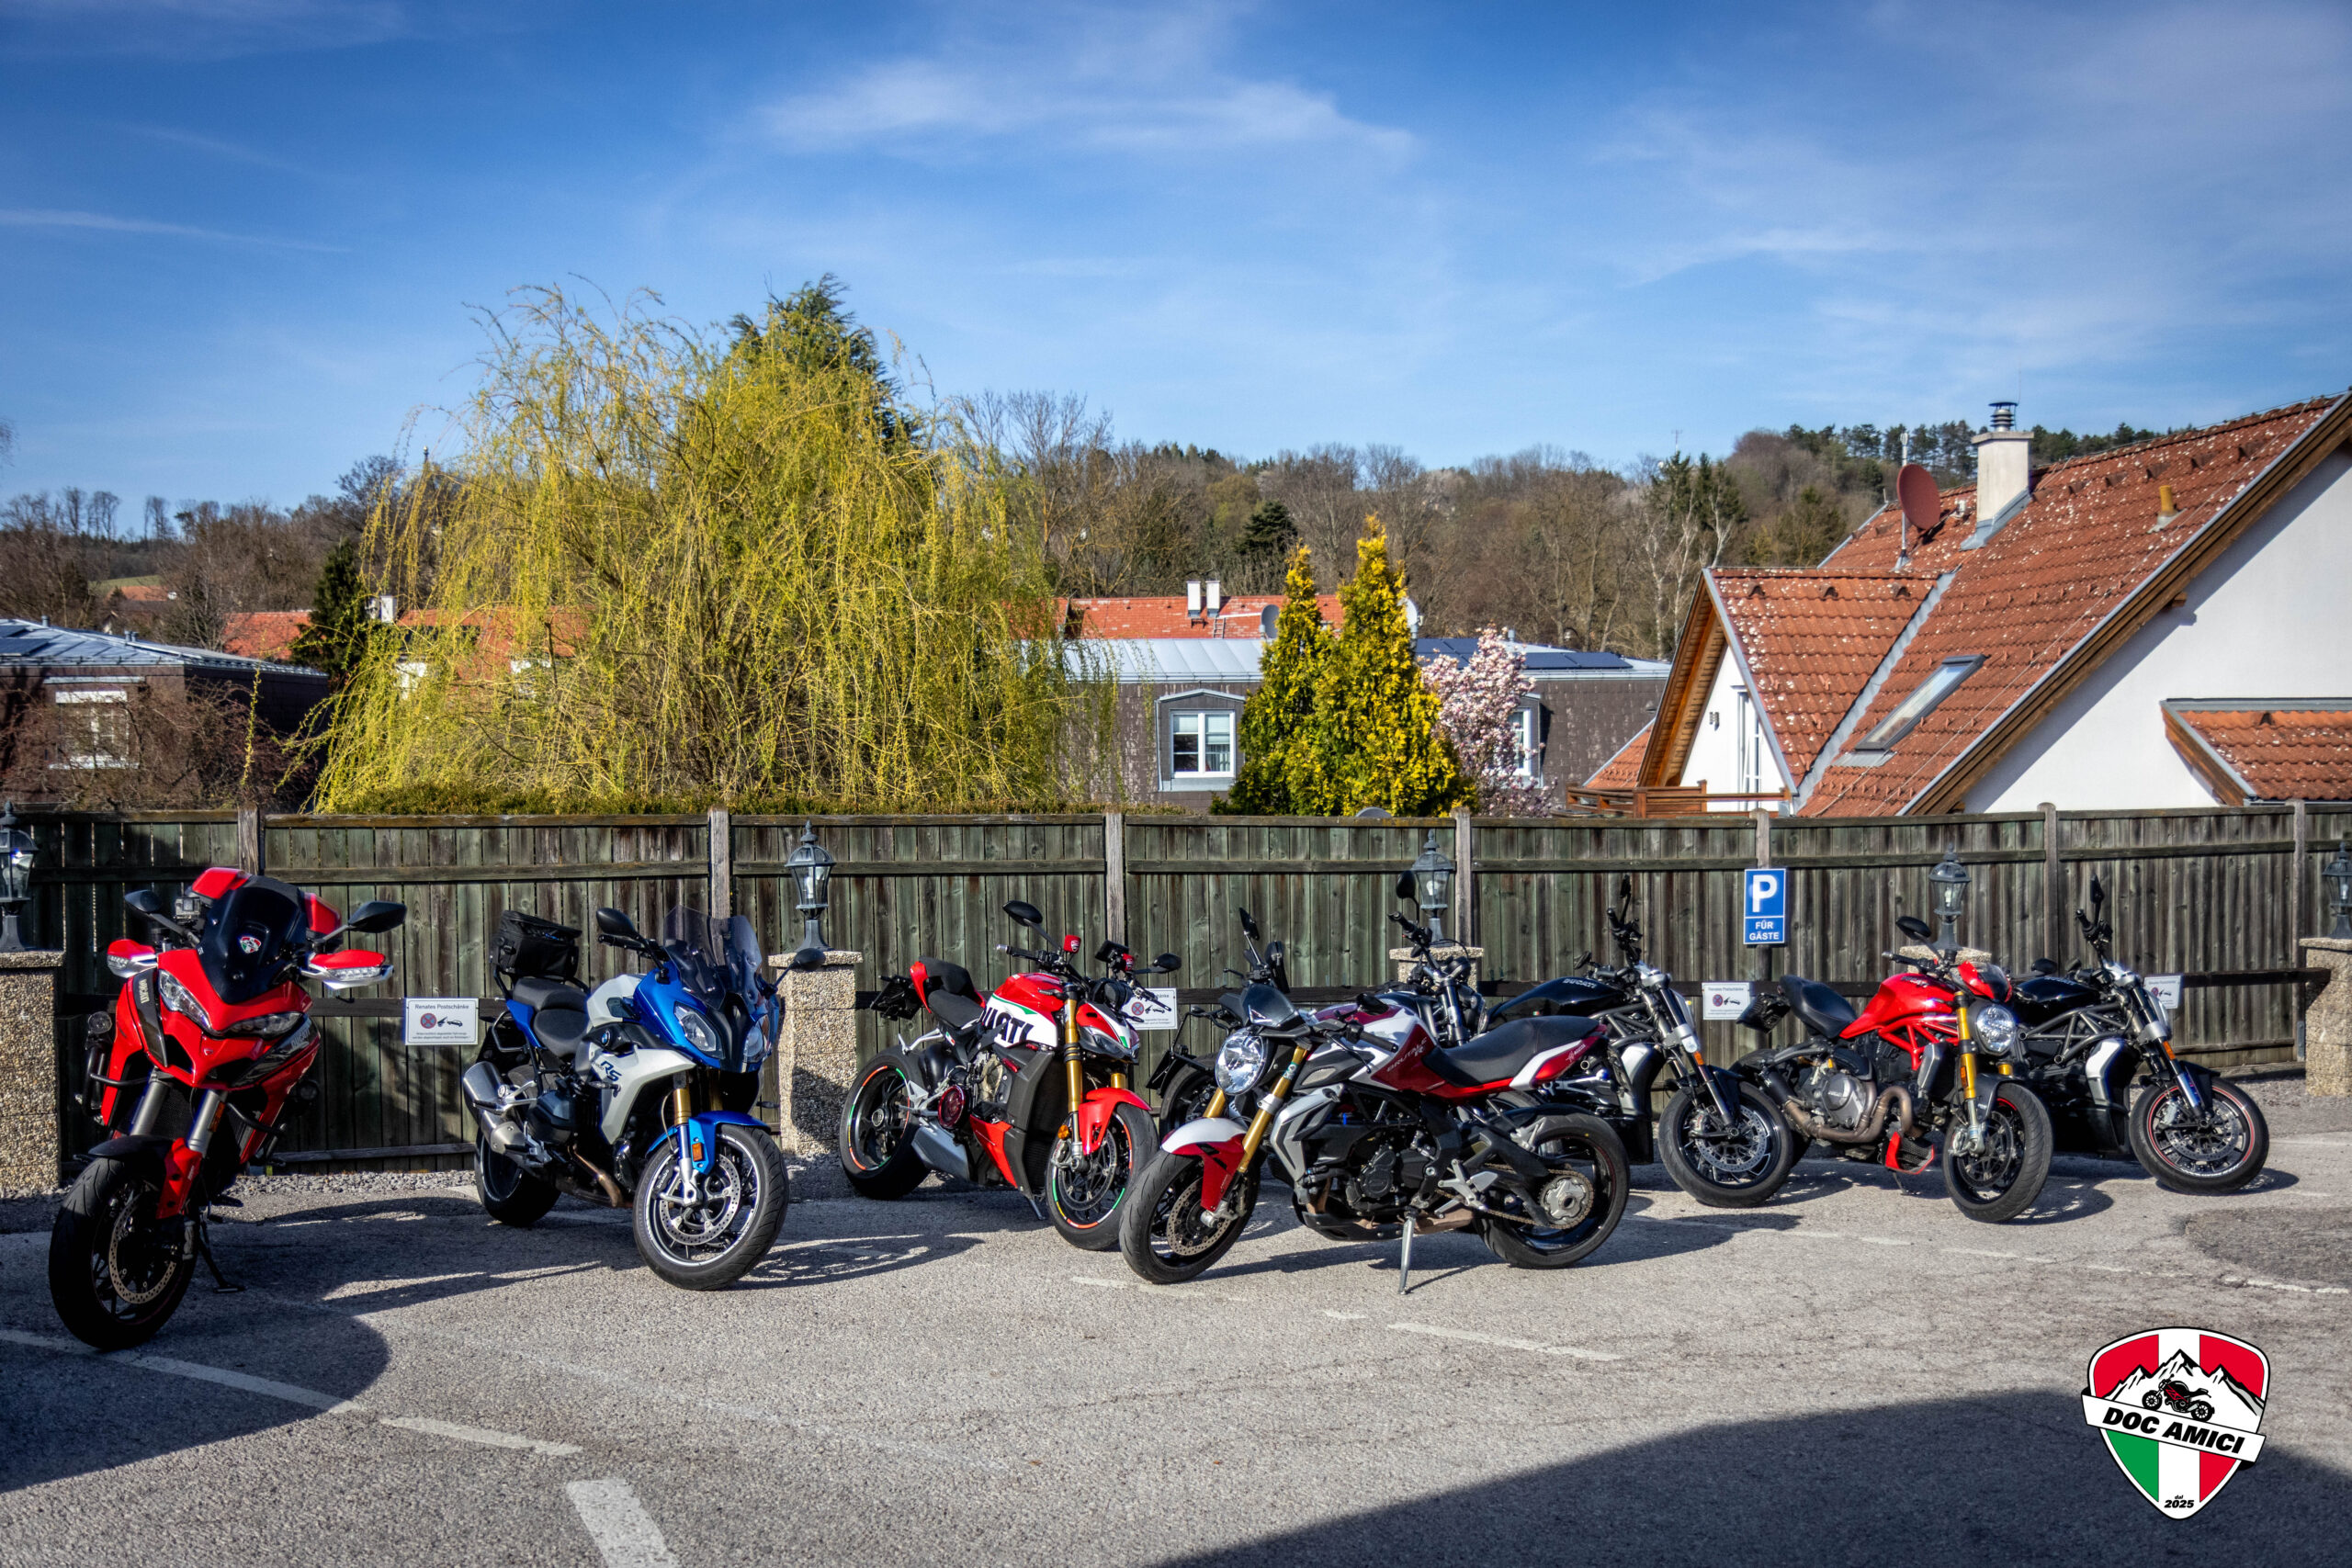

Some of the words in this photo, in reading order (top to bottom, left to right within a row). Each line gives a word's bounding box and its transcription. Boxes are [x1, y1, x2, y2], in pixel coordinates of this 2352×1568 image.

[1752, 874, 1778, 913] P
[1756, 919, 1774, 930] FÜR
[1749, 931, 1780, 941] GÄSTE
[1563, 978, 1598, 989] DUCATI
[600, 1060, 623, 1082] RS
